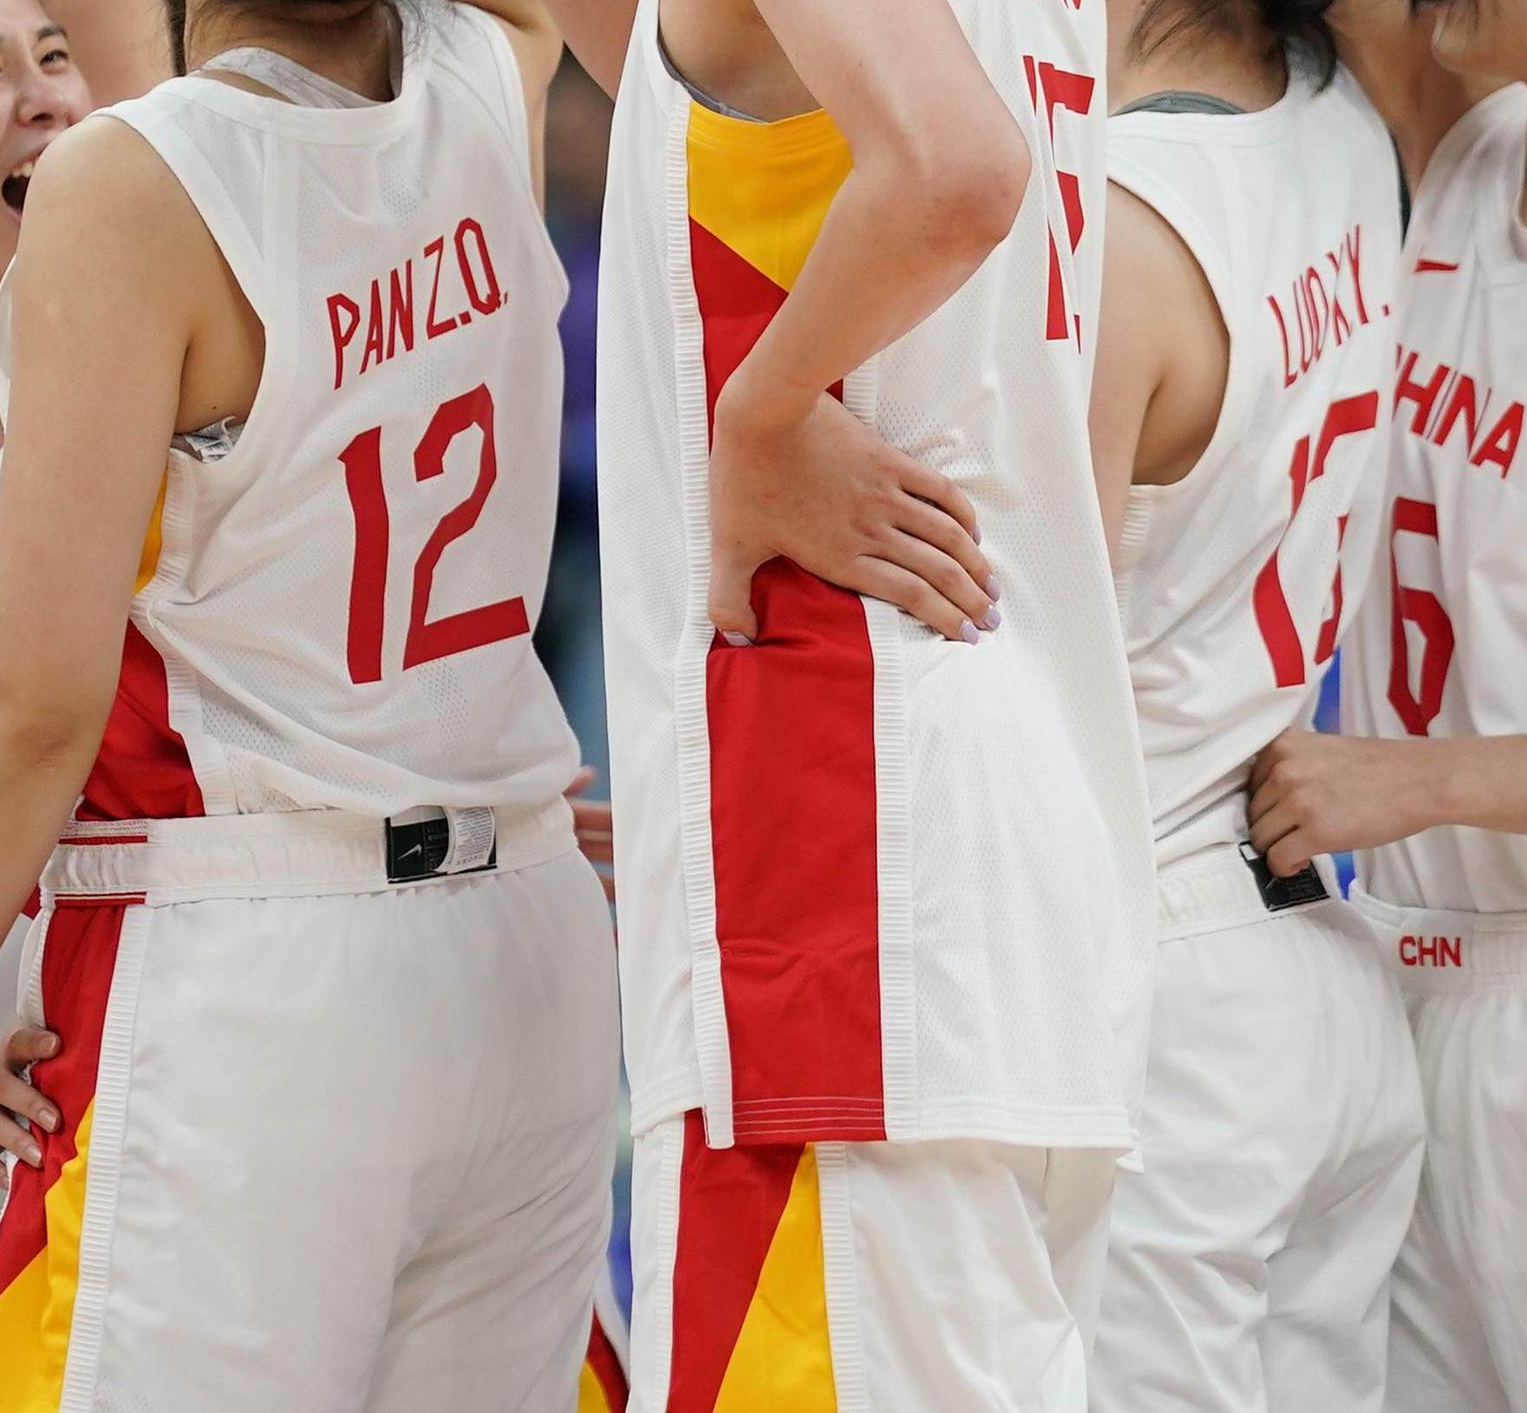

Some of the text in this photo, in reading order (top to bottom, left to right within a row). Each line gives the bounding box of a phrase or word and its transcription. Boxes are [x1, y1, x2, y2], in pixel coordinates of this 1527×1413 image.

[327, 259, 414, 390] PAN
[1392, 343, 1525, 480] HINA
[338, 382, 531, 686] 12
[1387, 496, 1456, 739] 6
[1398, 935, 1462, 968] CHN
